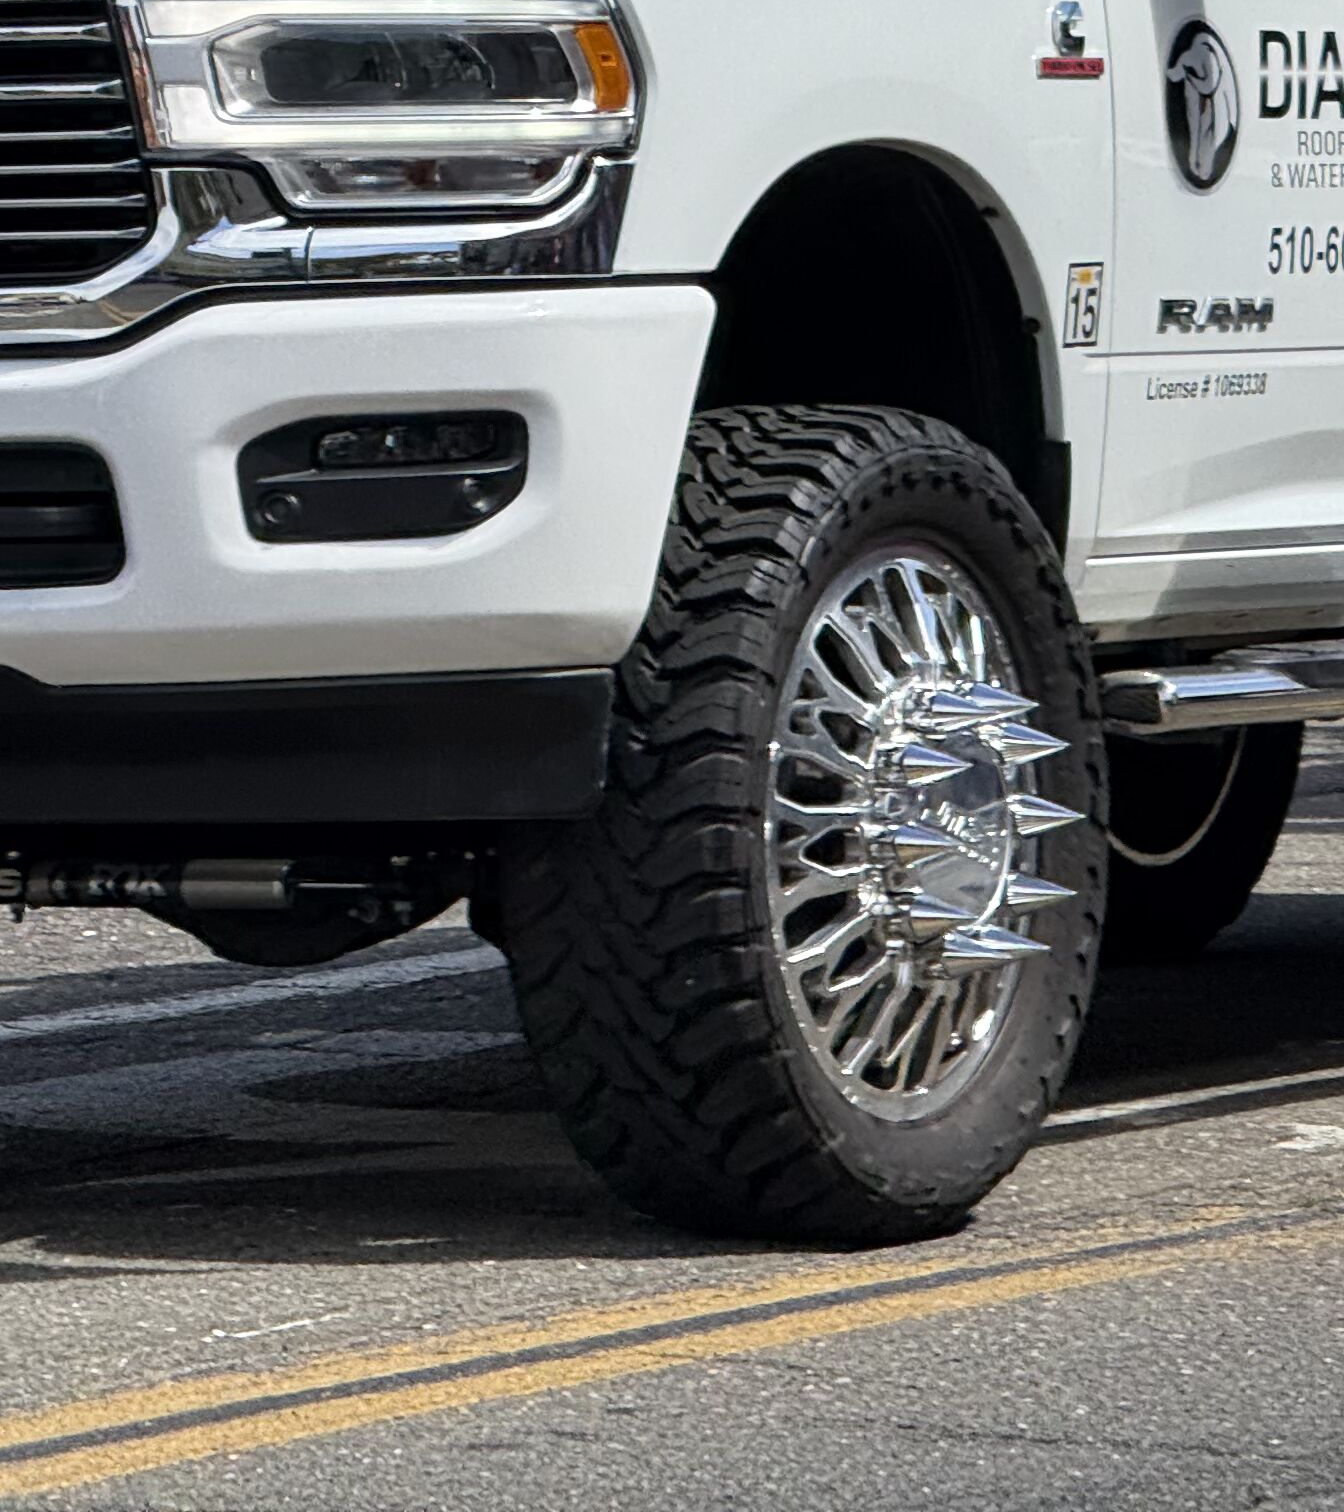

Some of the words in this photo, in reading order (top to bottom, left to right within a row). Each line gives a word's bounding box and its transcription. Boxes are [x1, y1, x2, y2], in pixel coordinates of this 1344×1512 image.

[1271, 163, 1283, 188] &
[1070, 287, 1098, 339] 15
[1156, 296, 1274, 334] RAM
[1146, 375, 1198, 400] License
